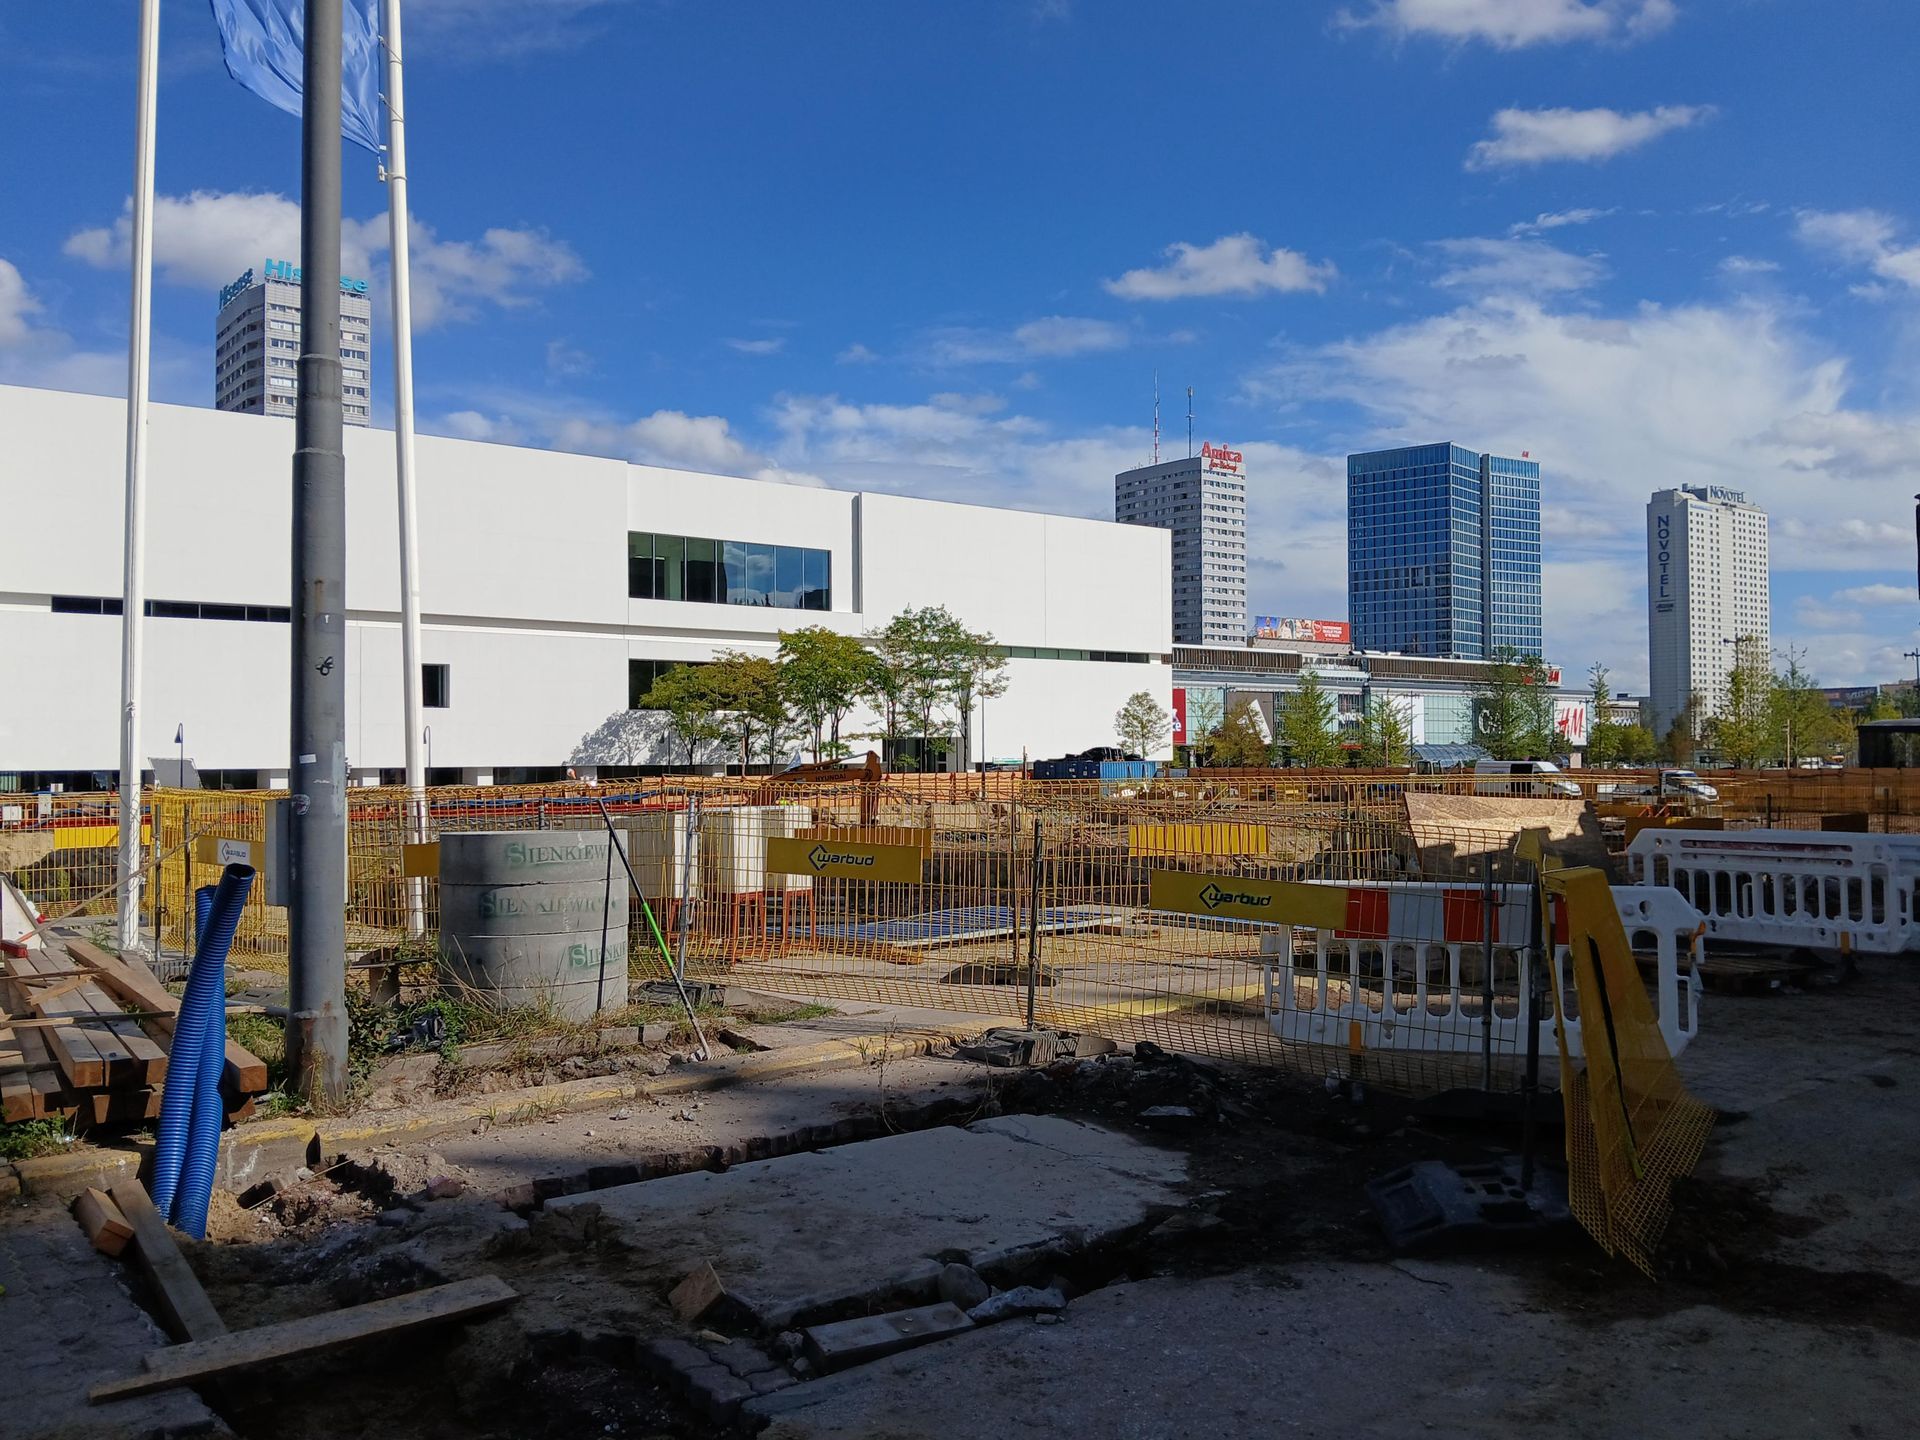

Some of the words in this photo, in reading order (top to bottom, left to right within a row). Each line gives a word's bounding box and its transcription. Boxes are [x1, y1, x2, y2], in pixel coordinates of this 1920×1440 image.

[264, 258, 369, 294] Hisse
[1201, 440, 1243, 463] Amica
[1709, 485, 1747, 504] NOVOTEL
[1657, 514, 1670, 598] NOVOTEL
[815, 773, 847, 782] HYUNDAI
[817, 852, 875, 867] warbud
[1208, 890, 1273, 907] warbud
